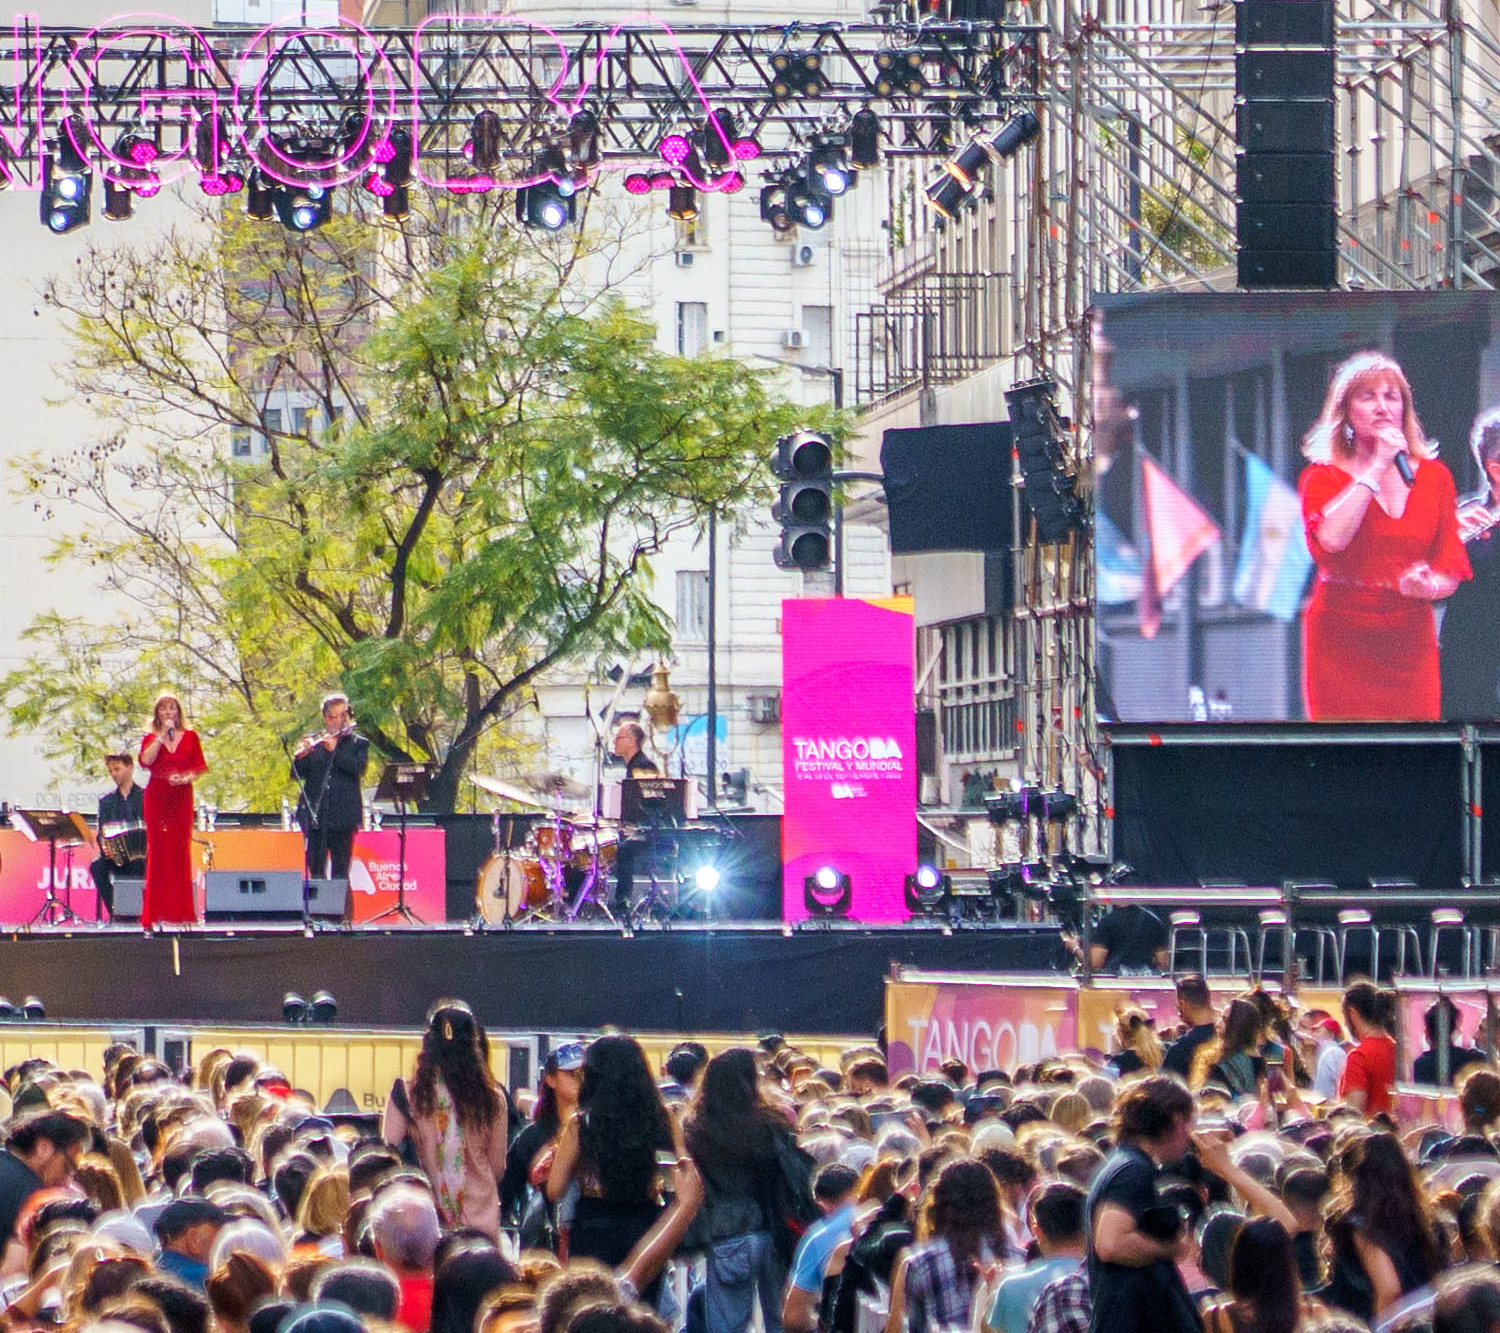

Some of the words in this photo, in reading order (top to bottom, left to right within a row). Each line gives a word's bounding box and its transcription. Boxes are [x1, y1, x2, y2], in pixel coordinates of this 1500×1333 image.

[793, 737, 904, 760] TANGOBA
[795, 760, 845, 771] FESTIVAL
[846, 760, 854, 771] Y
[855, 760, 904, 771] MUNDIAL
[907, 1017, 1058, 1075] TANGOBA
